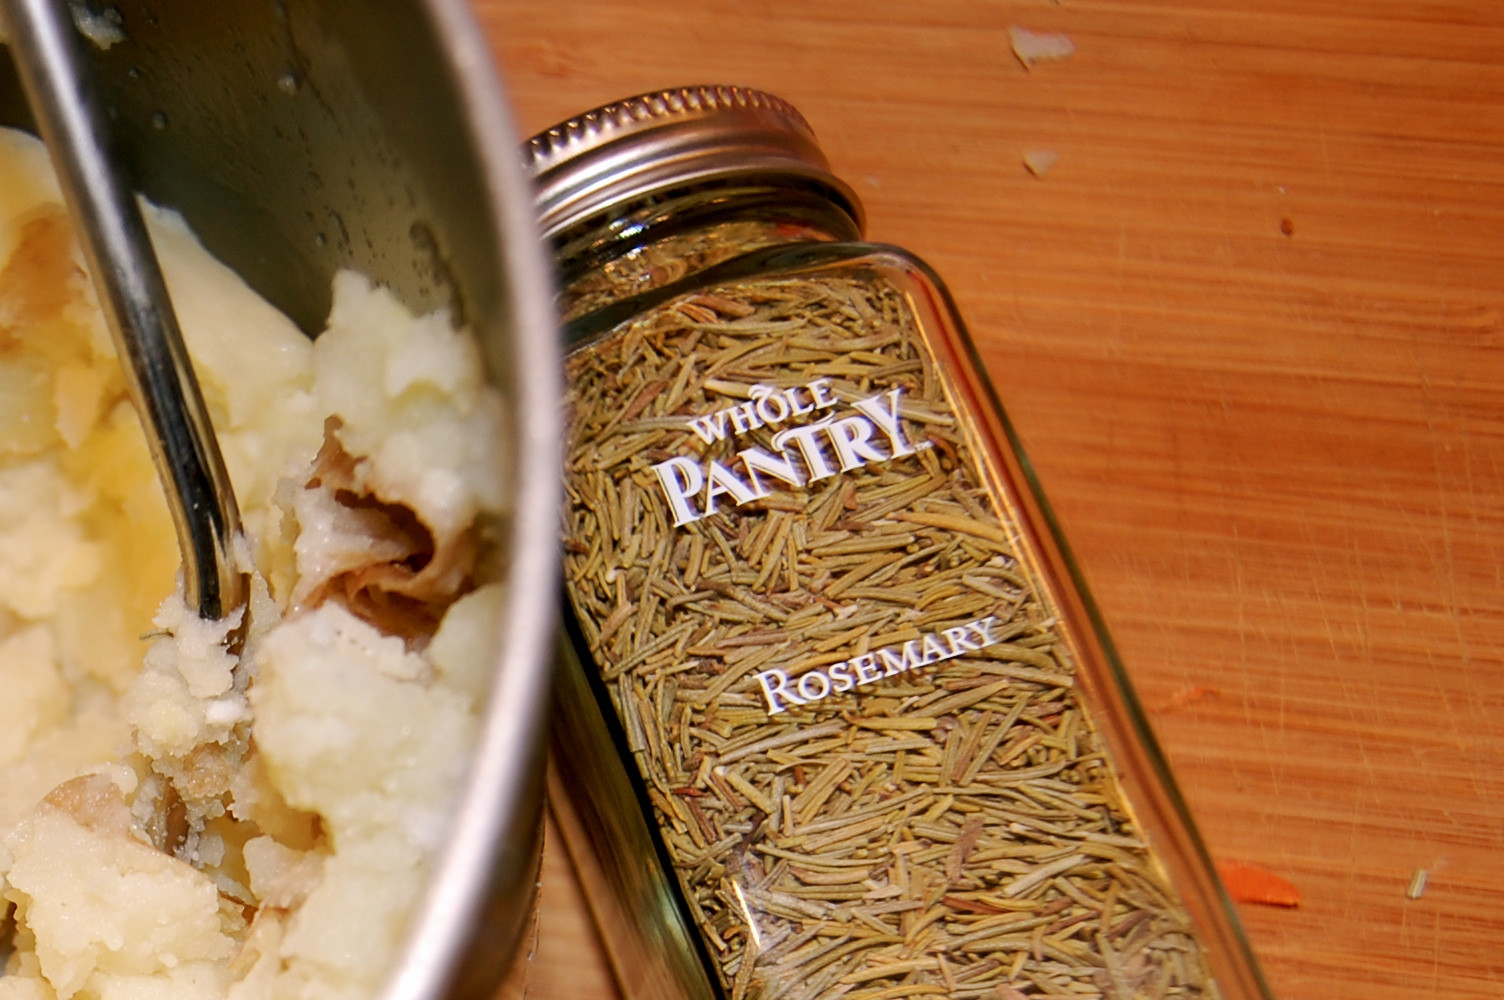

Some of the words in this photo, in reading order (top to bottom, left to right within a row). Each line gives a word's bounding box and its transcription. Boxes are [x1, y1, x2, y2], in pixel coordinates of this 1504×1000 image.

[651, 388, 920, 529] PANTRY
[688, 378, 839, 446] WHOLE
[753, 616, 998, 716] ROSEMARY
